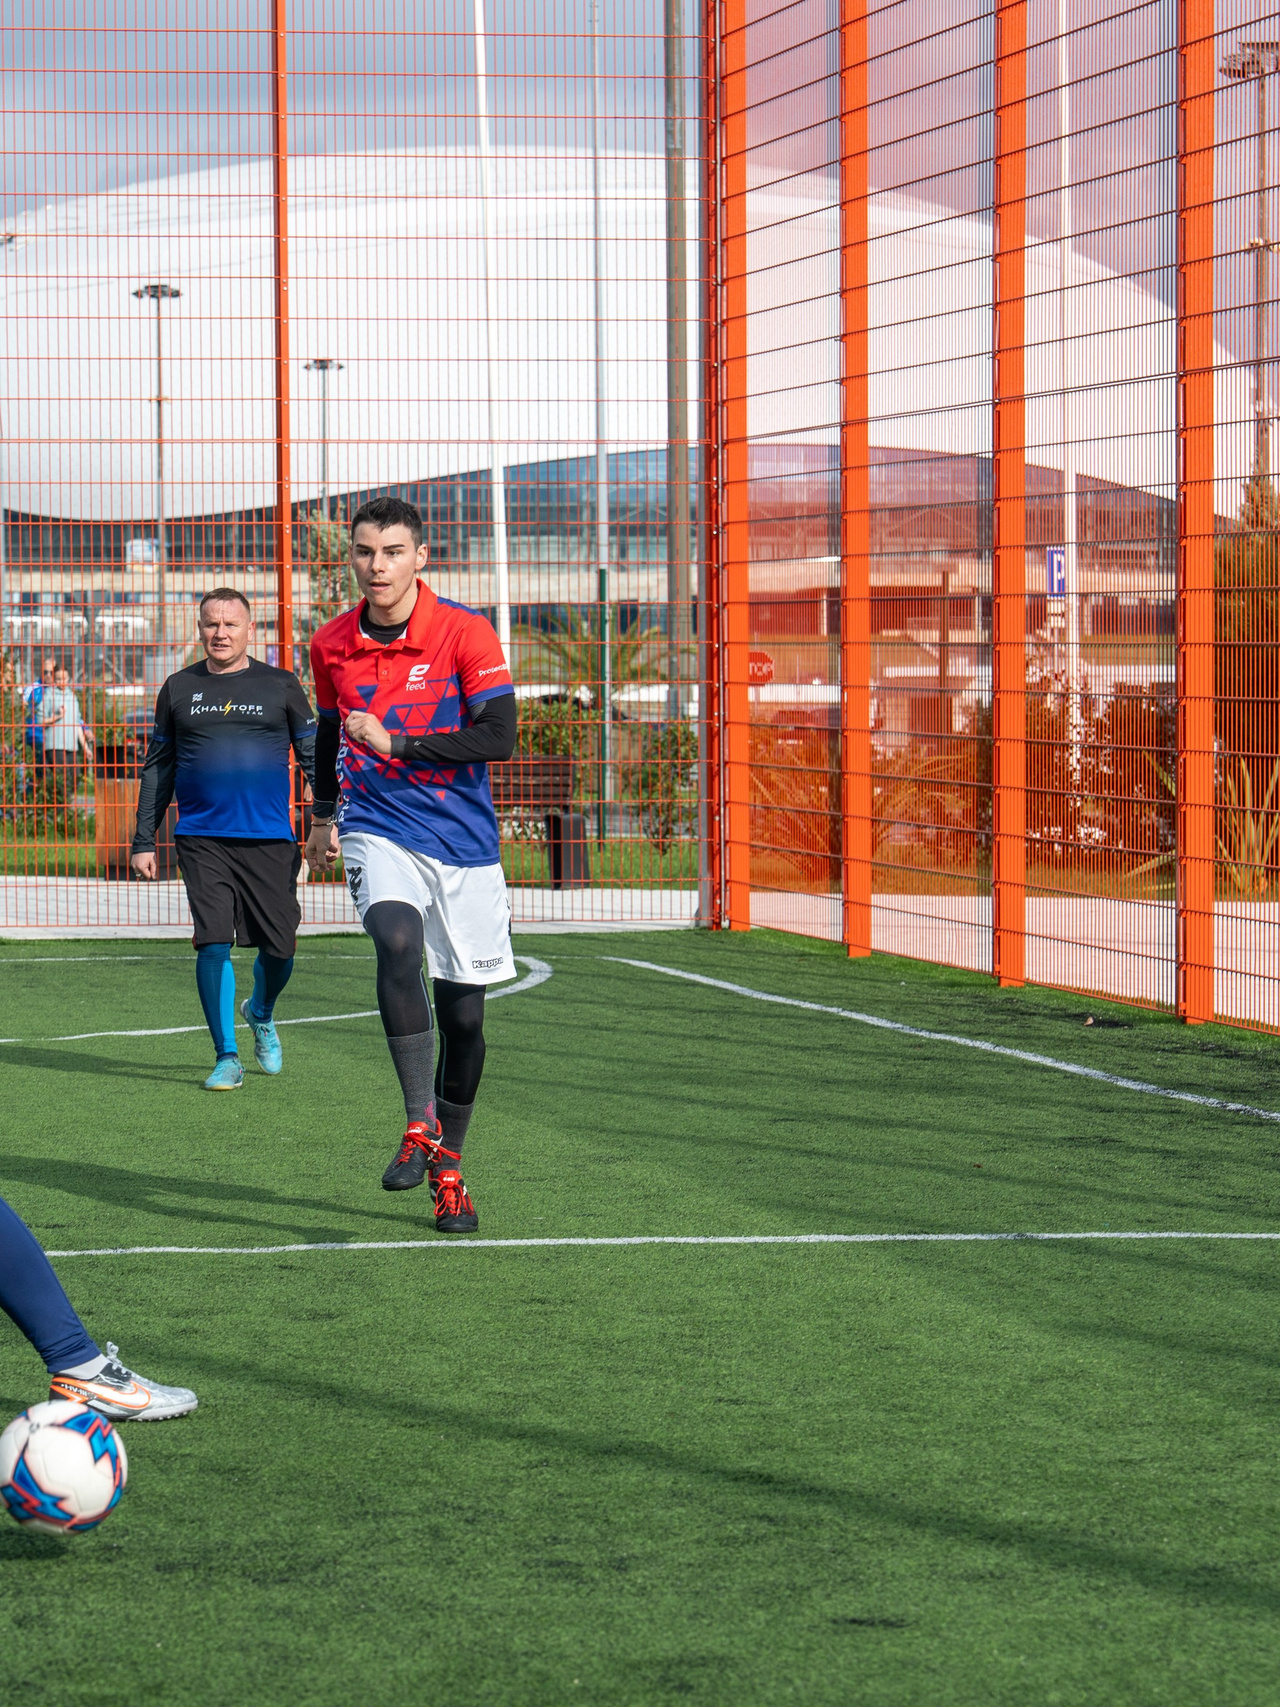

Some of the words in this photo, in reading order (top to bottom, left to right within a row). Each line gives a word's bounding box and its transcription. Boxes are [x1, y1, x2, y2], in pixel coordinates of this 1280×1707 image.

[1053, 552, 1066, 593] P
[406, 679, 426, 692] feed
[471, 956, 504, 969] Kappa
